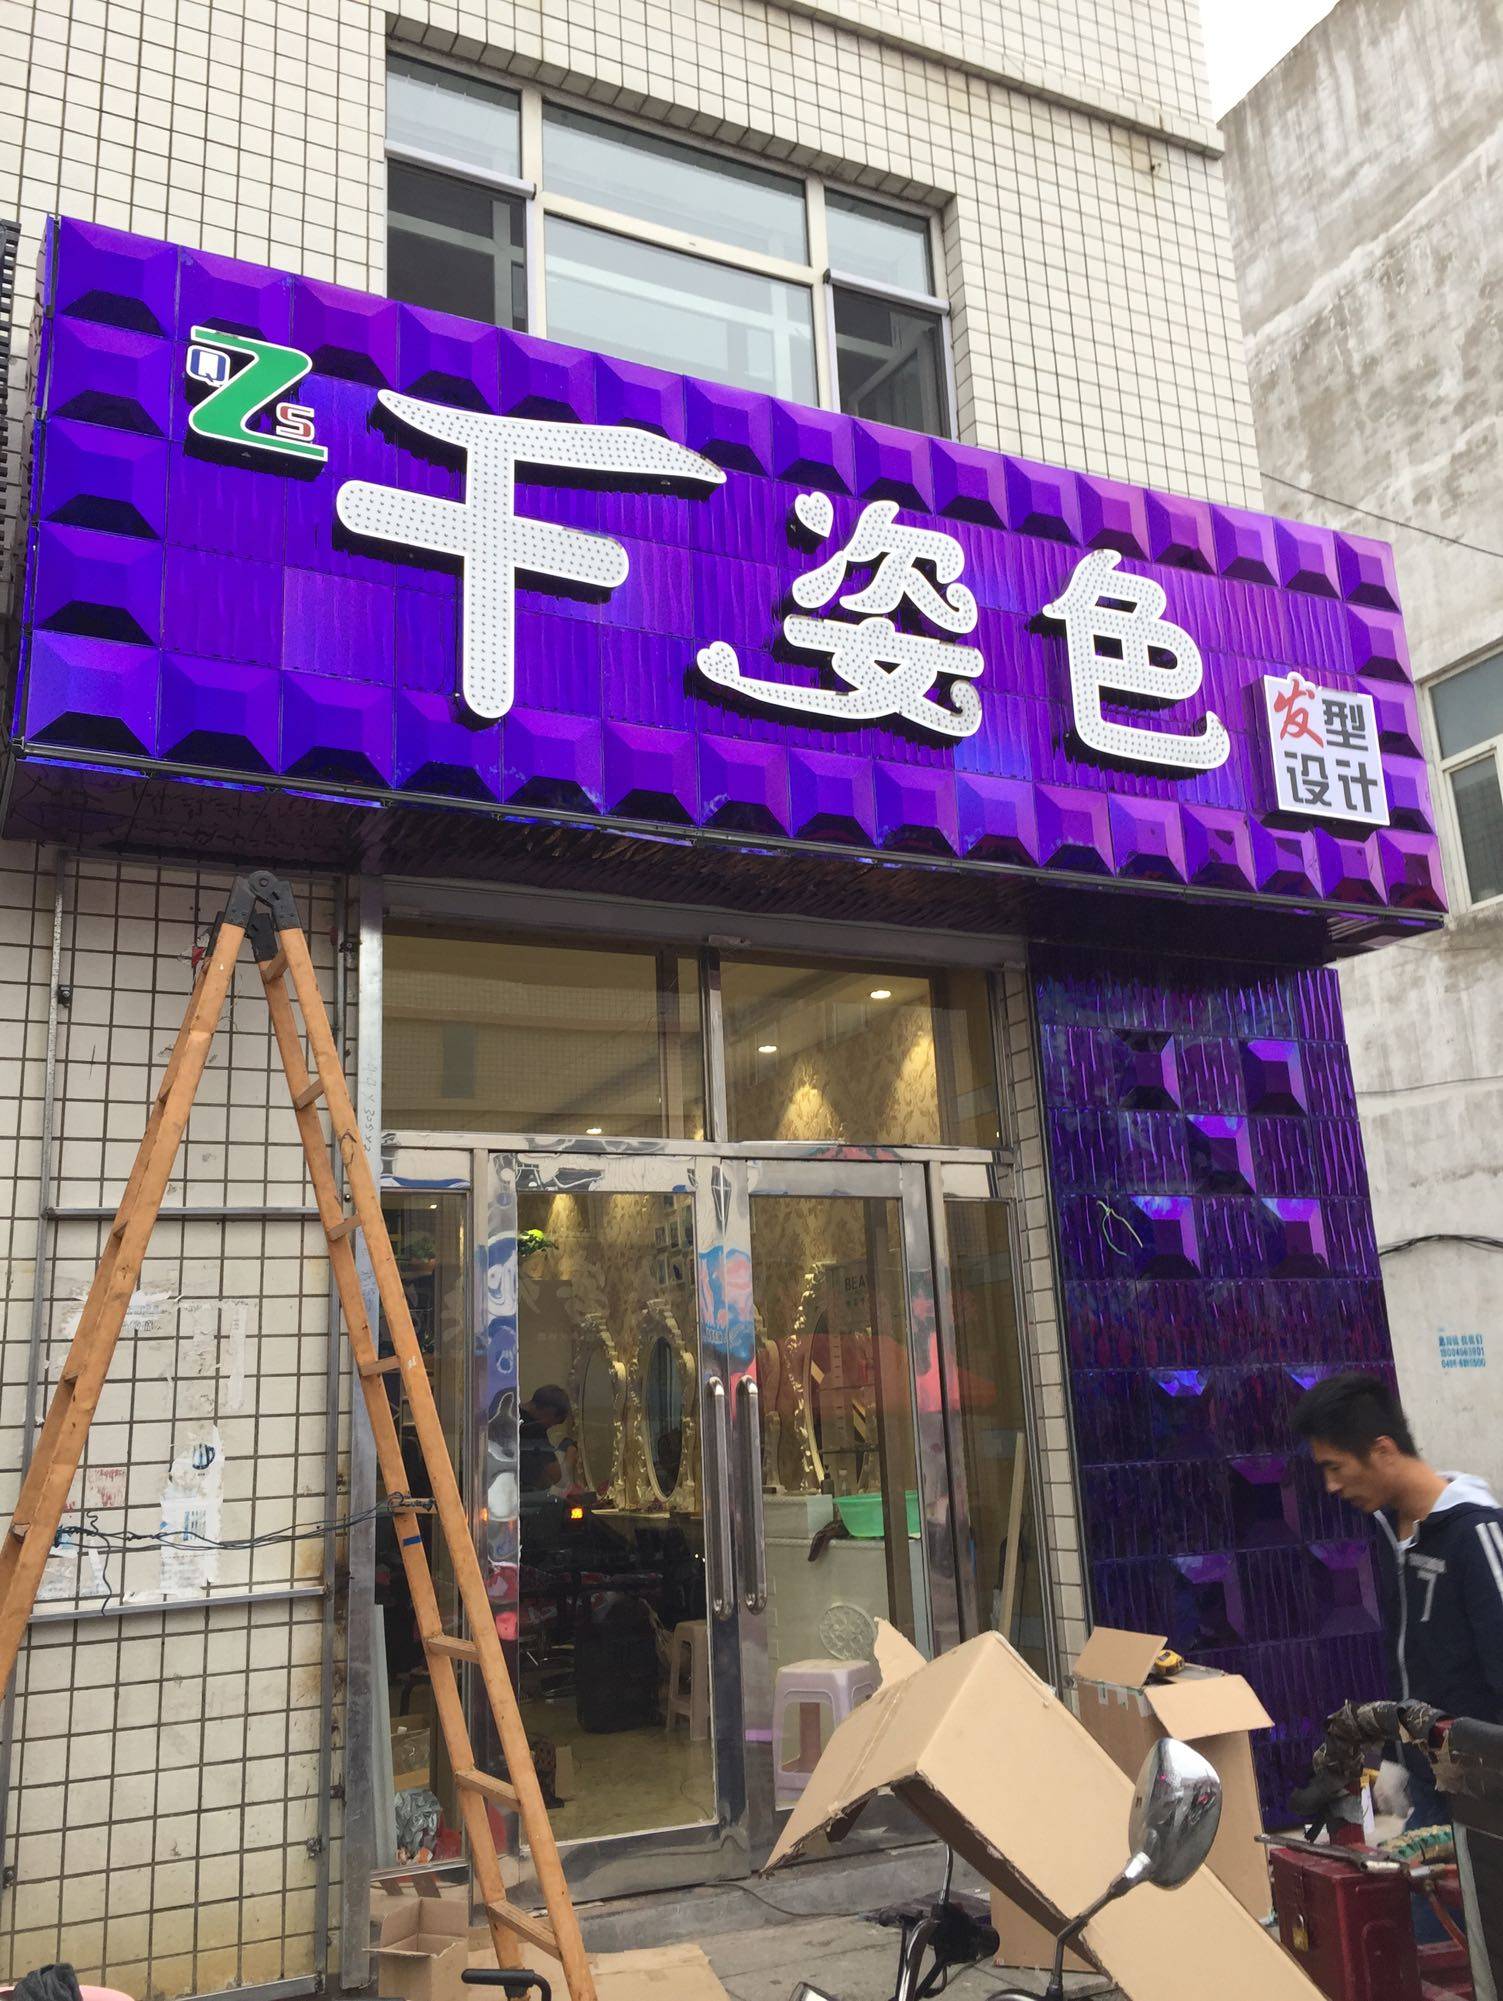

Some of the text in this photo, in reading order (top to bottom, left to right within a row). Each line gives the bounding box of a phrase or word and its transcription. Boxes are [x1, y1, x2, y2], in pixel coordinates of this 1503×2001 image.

[336, 388, 1231, 769] 千姿色
[1273, 678, 1370, 752] 发型
[1284, 751, 1378, 813] 设计
[844, 1275, 868, 1291] BEA
